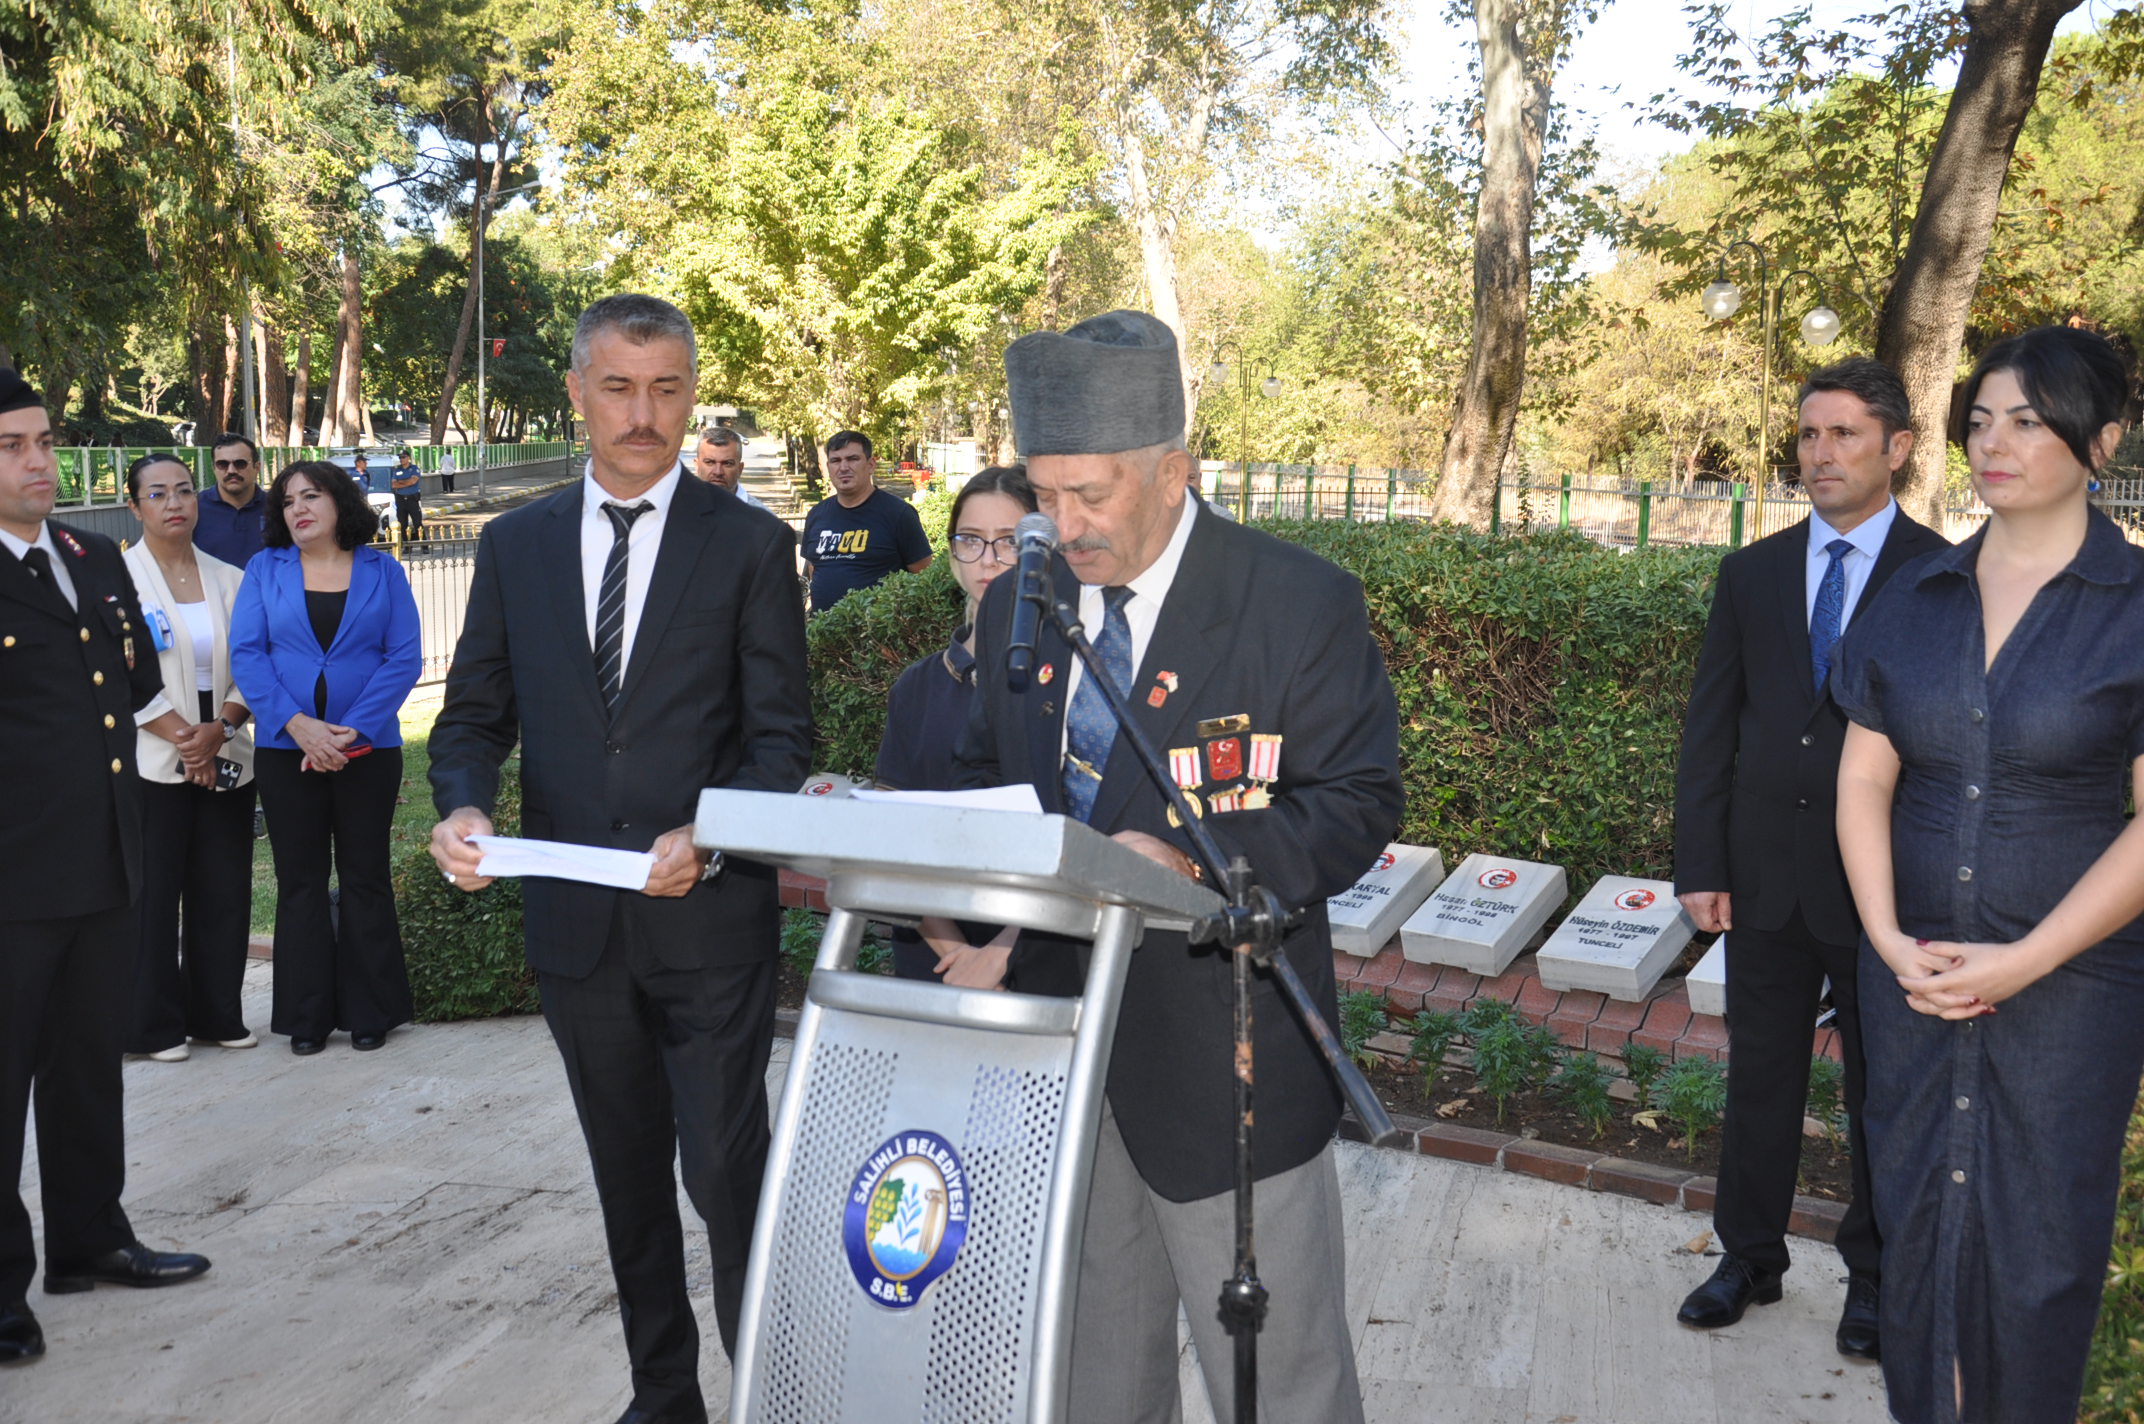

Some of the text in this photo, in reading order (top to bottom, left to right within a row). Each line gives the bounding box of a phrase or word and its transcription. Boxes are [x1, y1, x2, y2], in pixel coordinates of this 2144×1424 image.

[1470, 897, 1519, 914] ÖZTÜRK
[1611, 920, 1660, 935] ÖZDEMİR
[853, 1137, 967, 1222] SALİHLİ BELEDİYESİ
